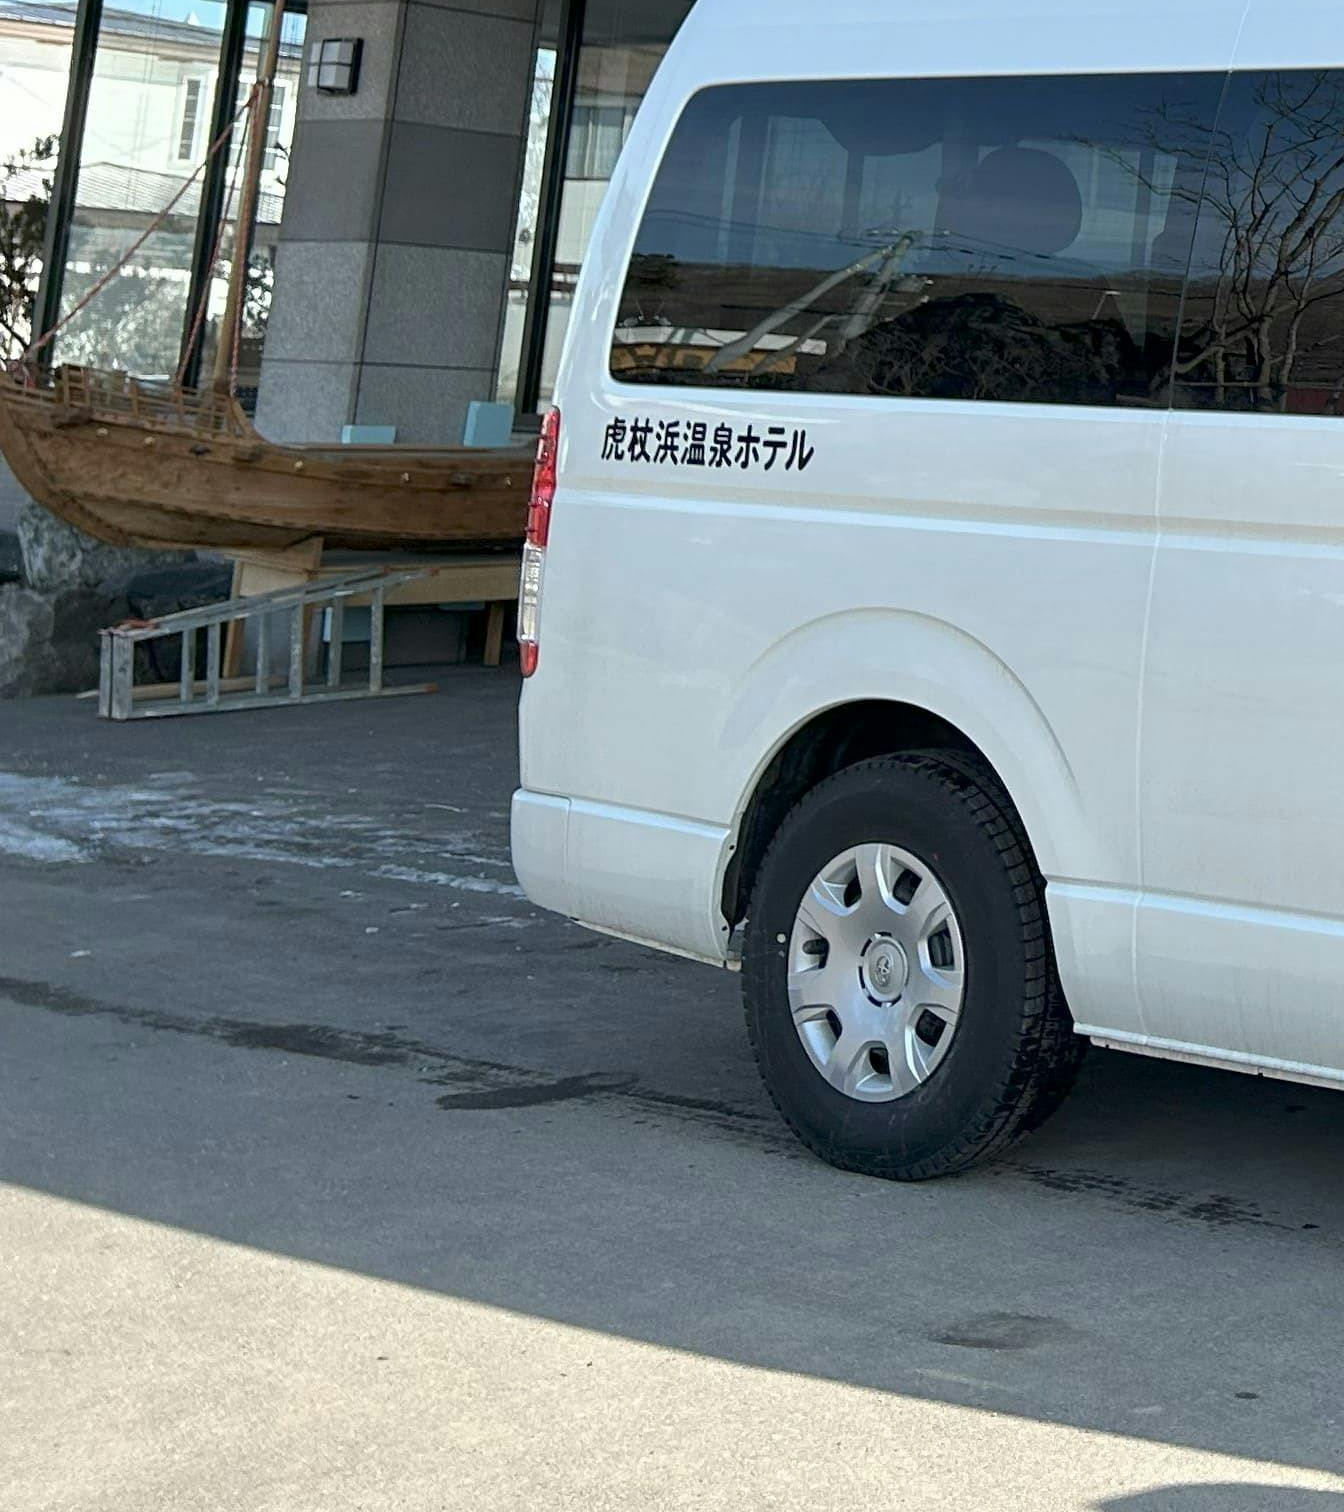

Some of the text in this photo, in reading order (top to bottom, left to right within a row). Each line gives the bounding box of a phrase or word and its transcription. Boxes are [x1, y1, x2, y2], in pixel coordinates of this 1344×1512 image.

[601, 416, 814, 471] 虎杖浜温泉ホテル
